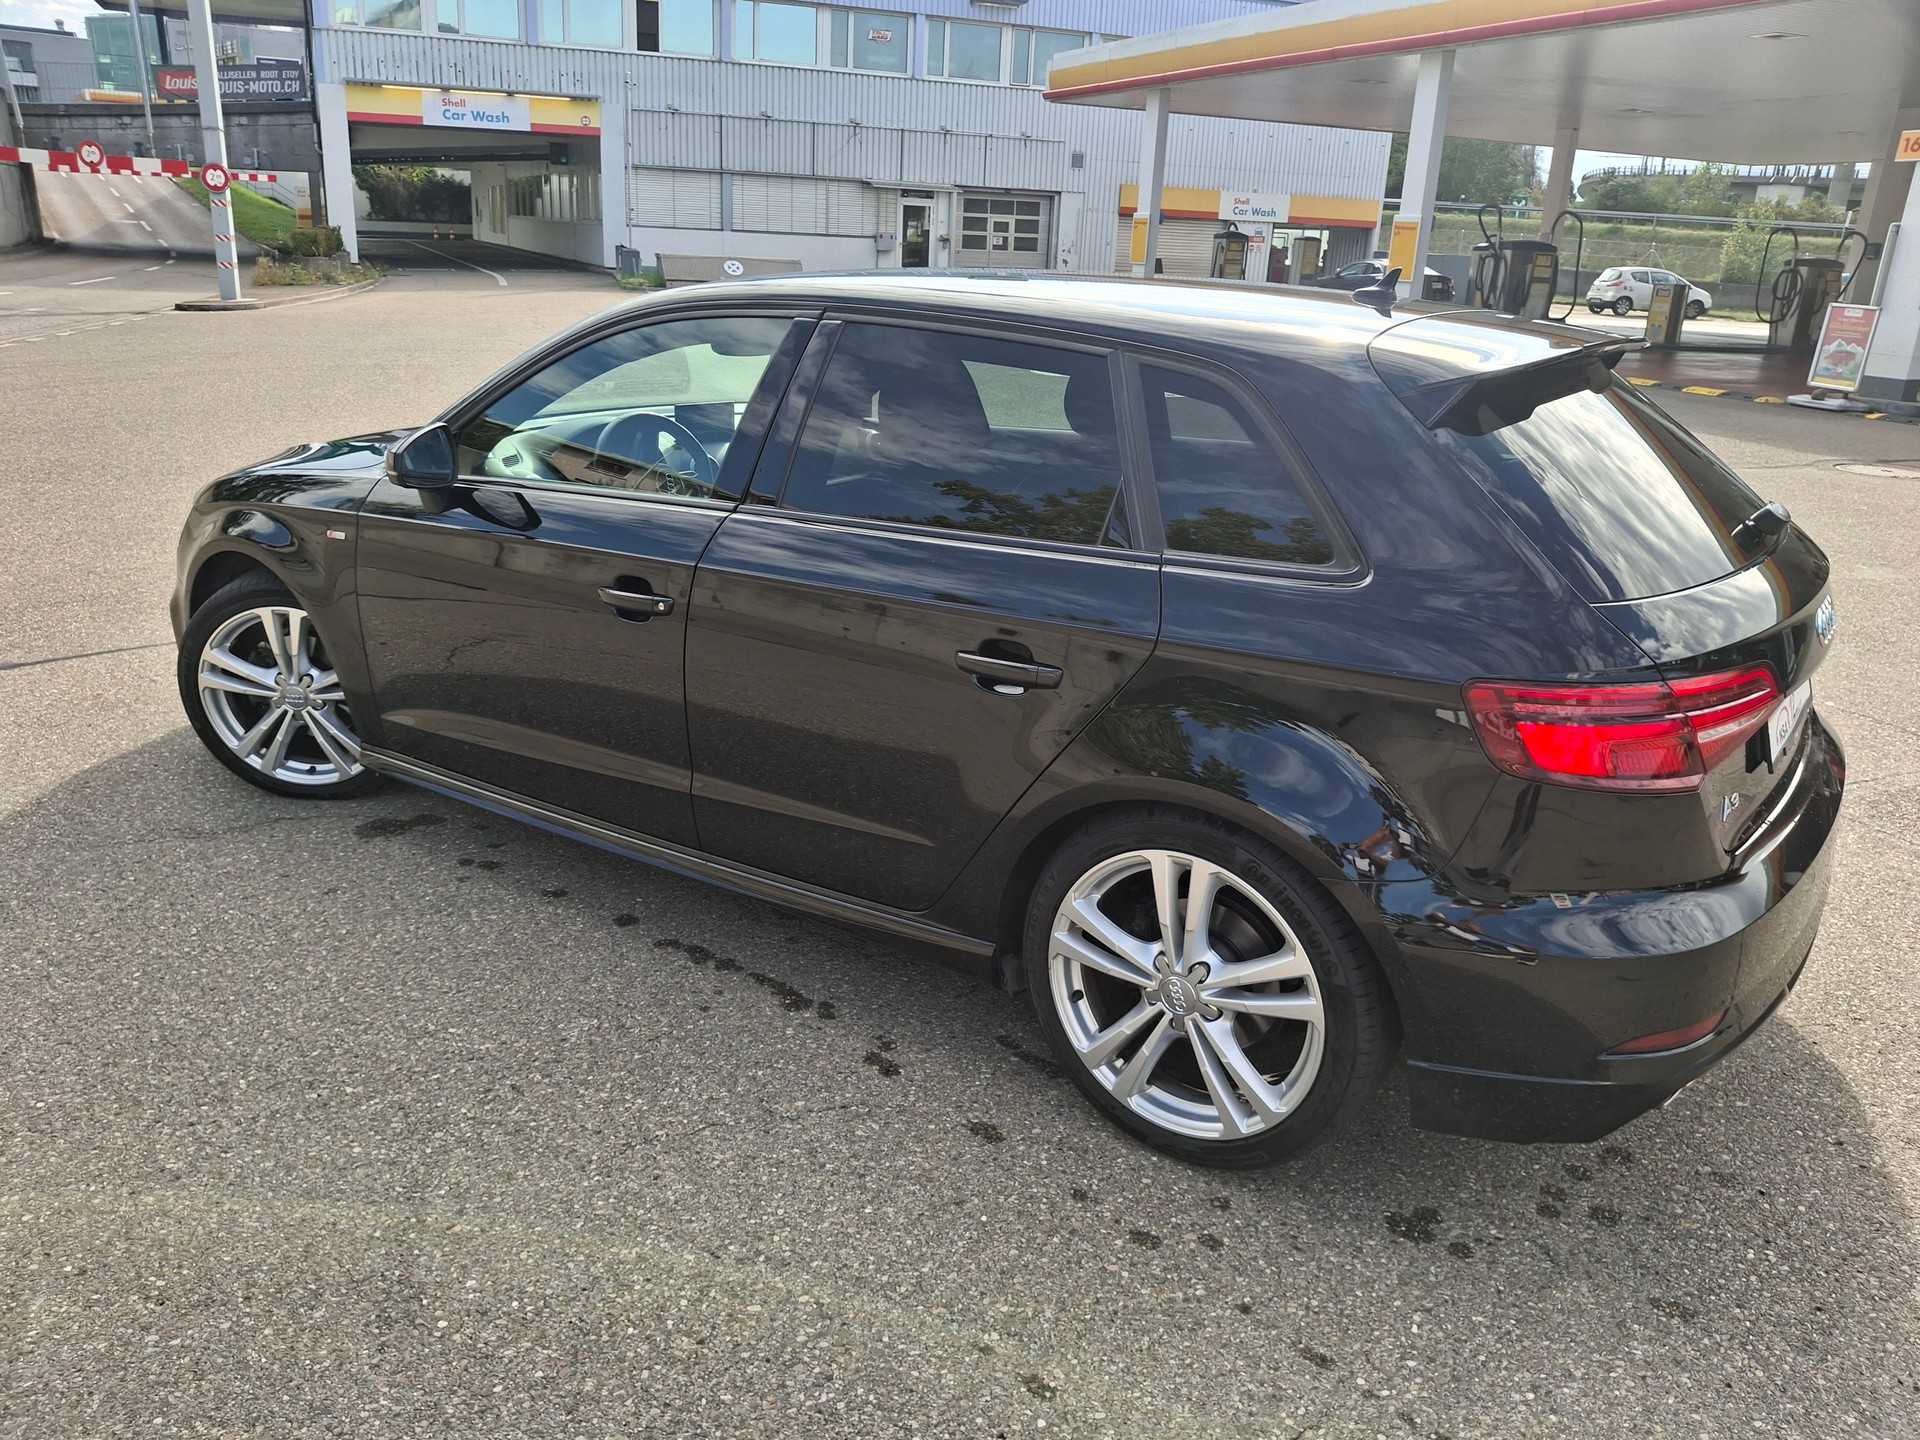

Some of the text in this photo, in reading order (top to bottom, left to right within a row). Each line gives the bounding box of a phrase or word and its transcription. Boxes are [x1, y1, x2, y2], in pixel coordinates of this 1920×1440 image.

[217, 70, 299, 79] ALLISELLEN ROOT ETOY
[165, 75, 198, 89] Louis
[219, 80, 300, 93] OUIS-MOTO.CH
[441, 98, 466, 108] Shell
[442, 109, 510, 123] Car Wash
[1233, 206, 1276, 217] Car Wash
[1721, 792, 1740, 822] A3
[1239, 858, 1331, 957] Continental
